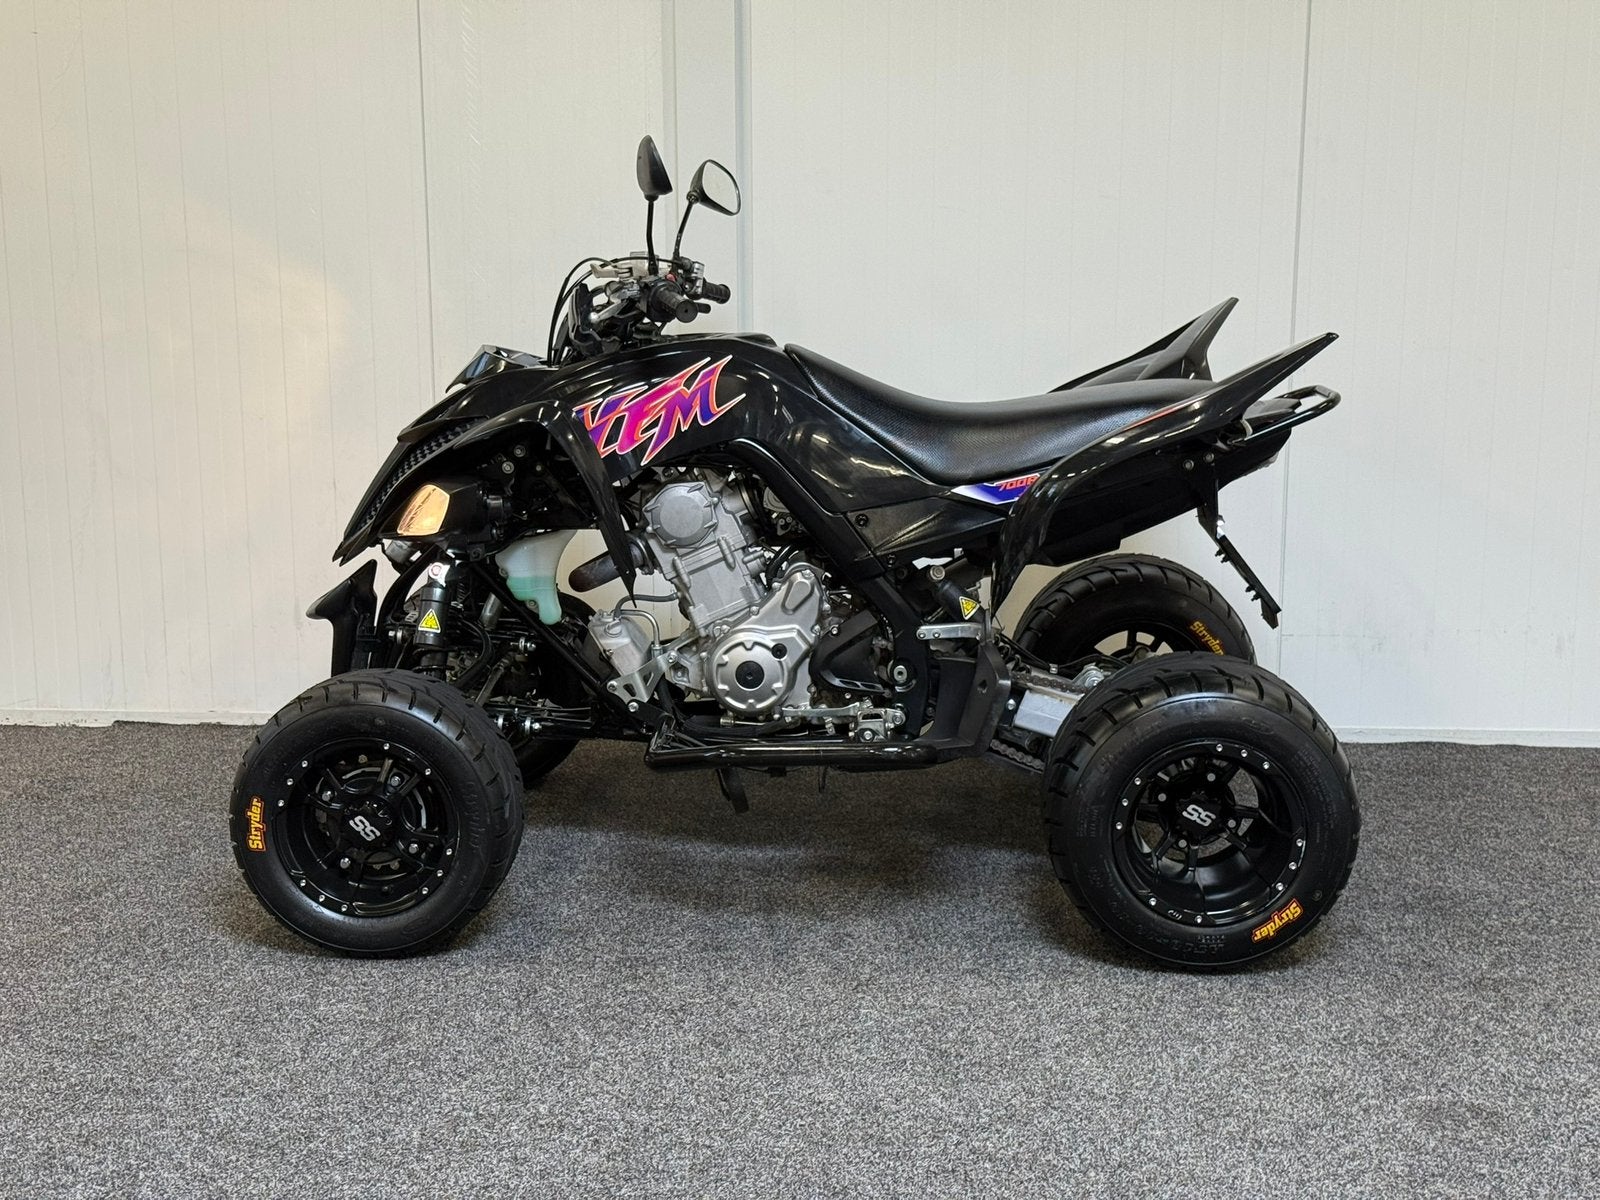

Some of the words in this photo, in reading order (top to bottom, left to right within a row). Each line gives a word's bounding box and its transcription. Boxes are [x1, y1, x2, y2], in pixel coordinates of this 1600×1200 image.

[1189, 620, 1225, 656] Stryder
[246, 795, 267, 852] Stryder
[1252, 897, 1304, 944] Stryder
